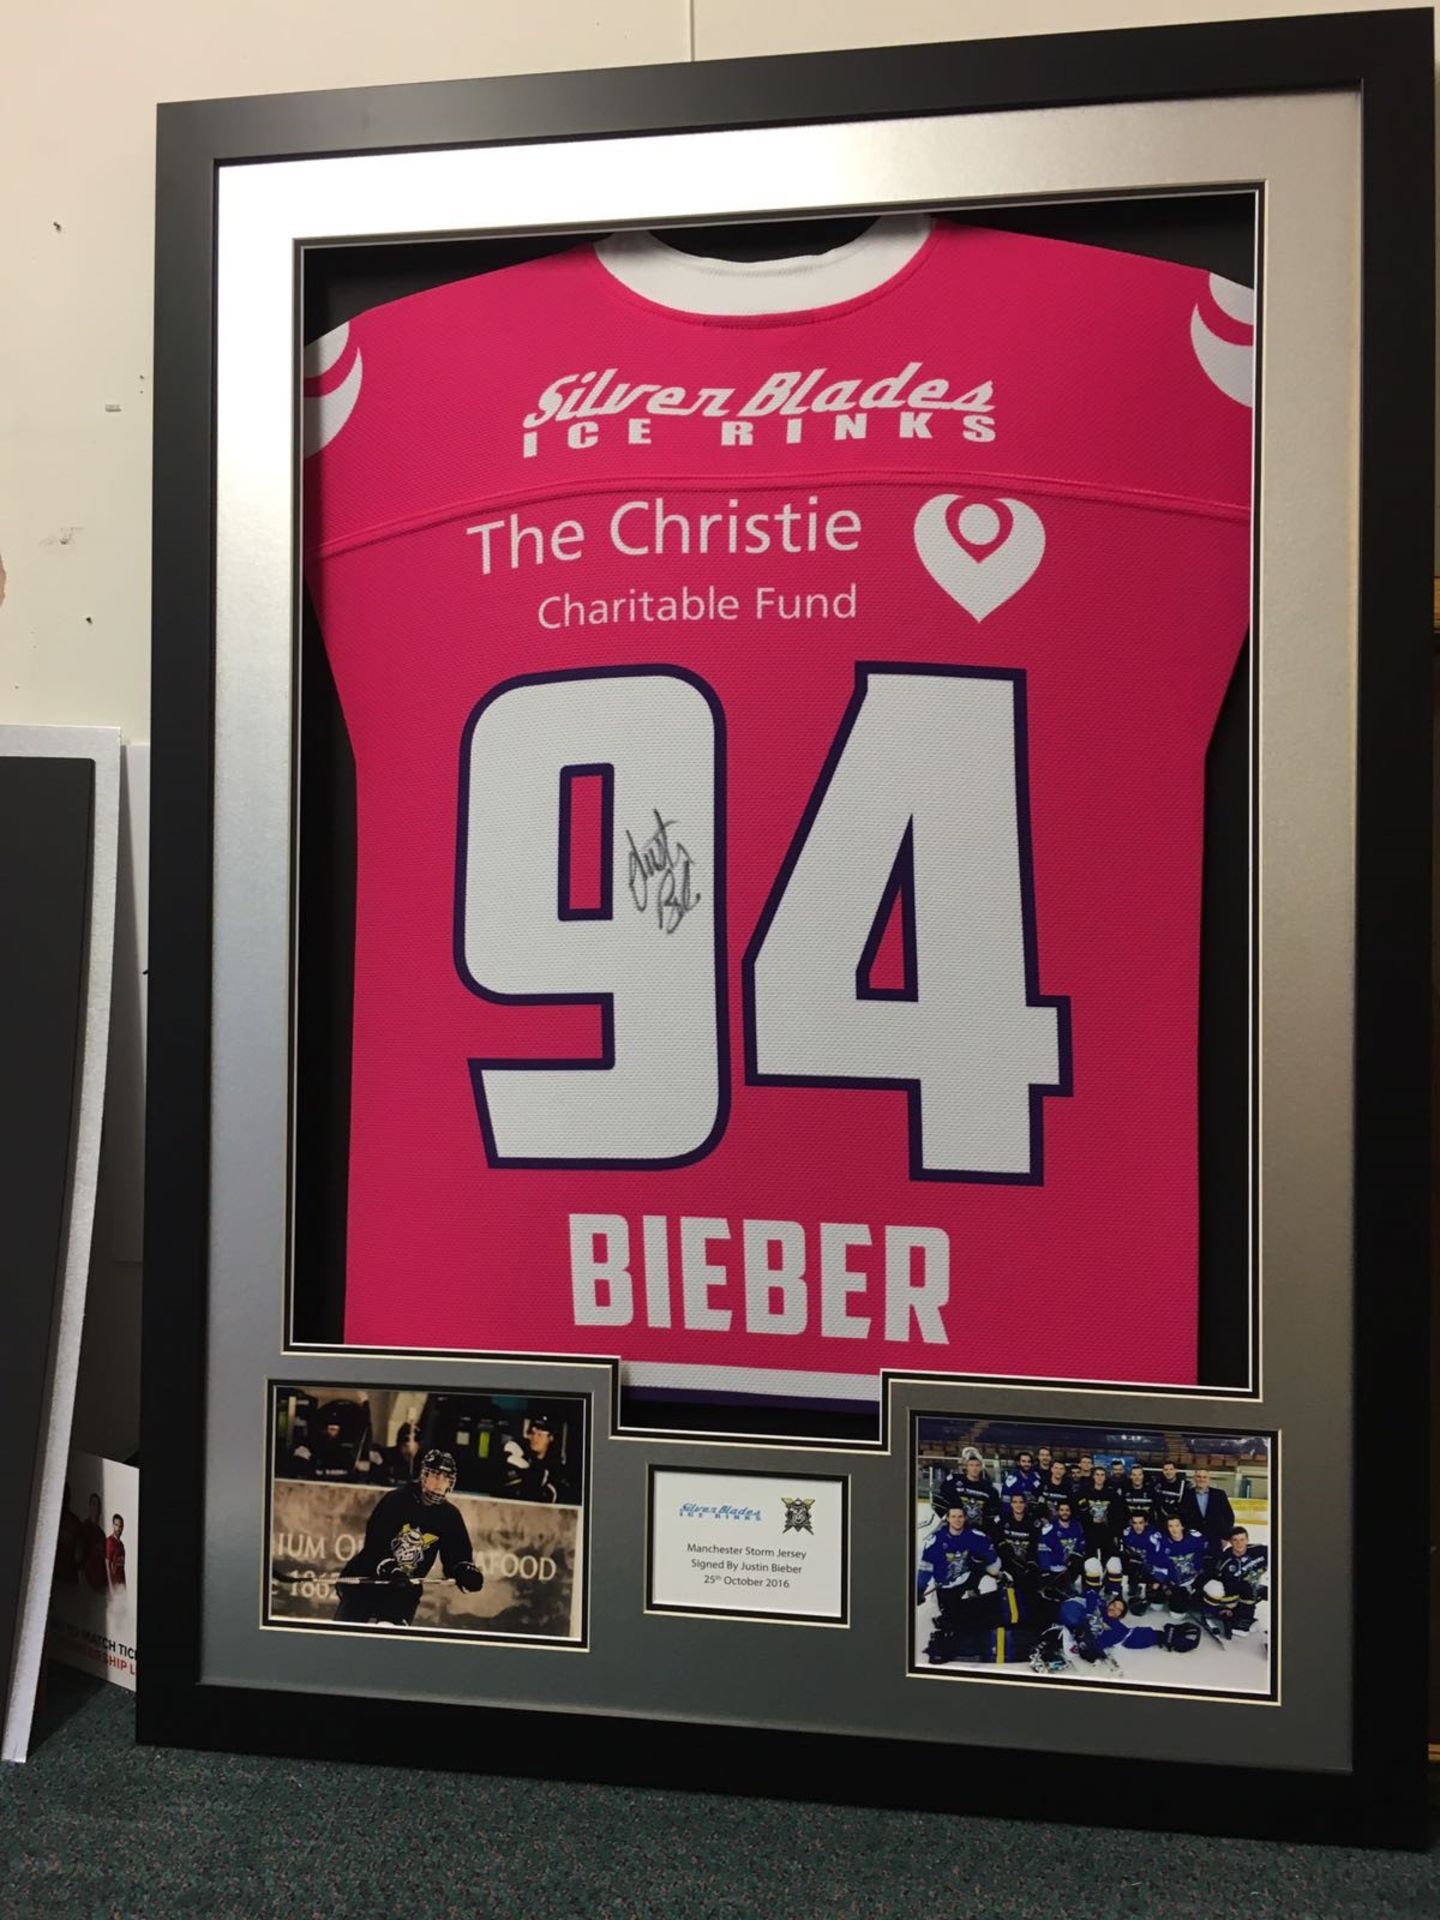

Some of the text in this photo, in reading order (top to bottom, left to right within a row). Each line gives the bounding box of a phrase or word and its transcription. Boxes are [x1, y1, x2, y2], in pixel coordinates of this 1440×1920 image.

[523, 361, 997, 429] Silver Blades
[523, 411, 997, 459] ICE RINKS
[466, 495, 863, 575] The Christie
[537, 582, 859, 629] Charitable Fund
[453, 660, 1074, 1187] 94
[568, 1212, 951, 1345] BIEBER
[686, 1543, 807, 1561] Manchester Storm Jersey
[691, 1559, 803, 1575] Signed By Justin Bieber
[723, 1576, 764, 1588] October
[765, 1578, 790, 1589] 2016
